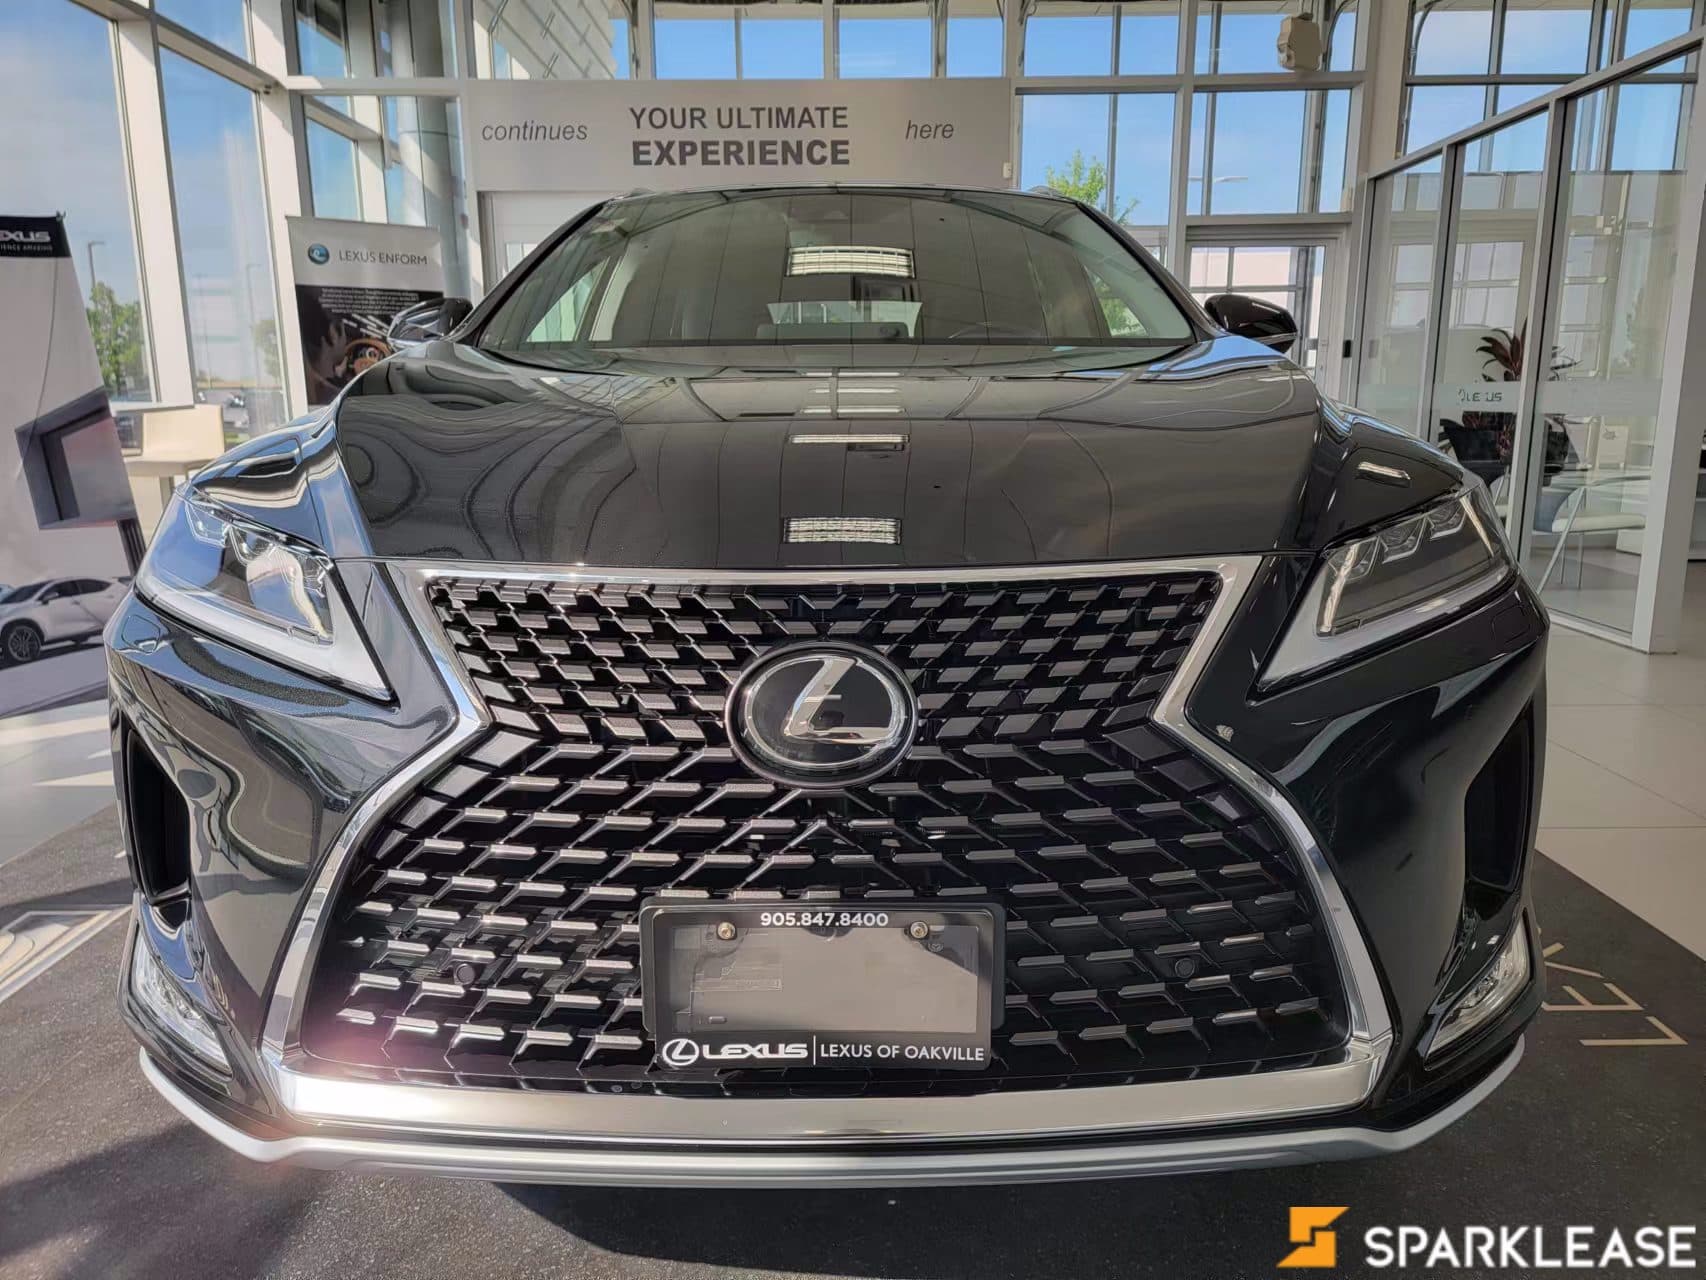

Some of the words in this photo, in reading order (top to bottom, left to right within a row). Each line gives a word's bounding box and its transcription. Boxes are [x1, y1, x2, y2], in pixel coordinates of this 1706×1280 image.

[629, 107, 707, 129] YOUR
[717, 106, 848, 129] ULTIMATE
[481, 120, 588, 141] continues
[905, 119, 954, 139] here
[632, 139, 849, 166] EXPERIENCE
[339, 250, 376, 263] LEXUS
[378, 252, 428, 265] ENFORM
[760, 912, 889, 927] 905.847.8400
[702, 1043, 809, 1060] LEXUS
[820, 1043, 872, 1058] LEXUS
[877, 1044, 900, 1059] OF
[904, 1045, 985, 1061] OAKVILLE
